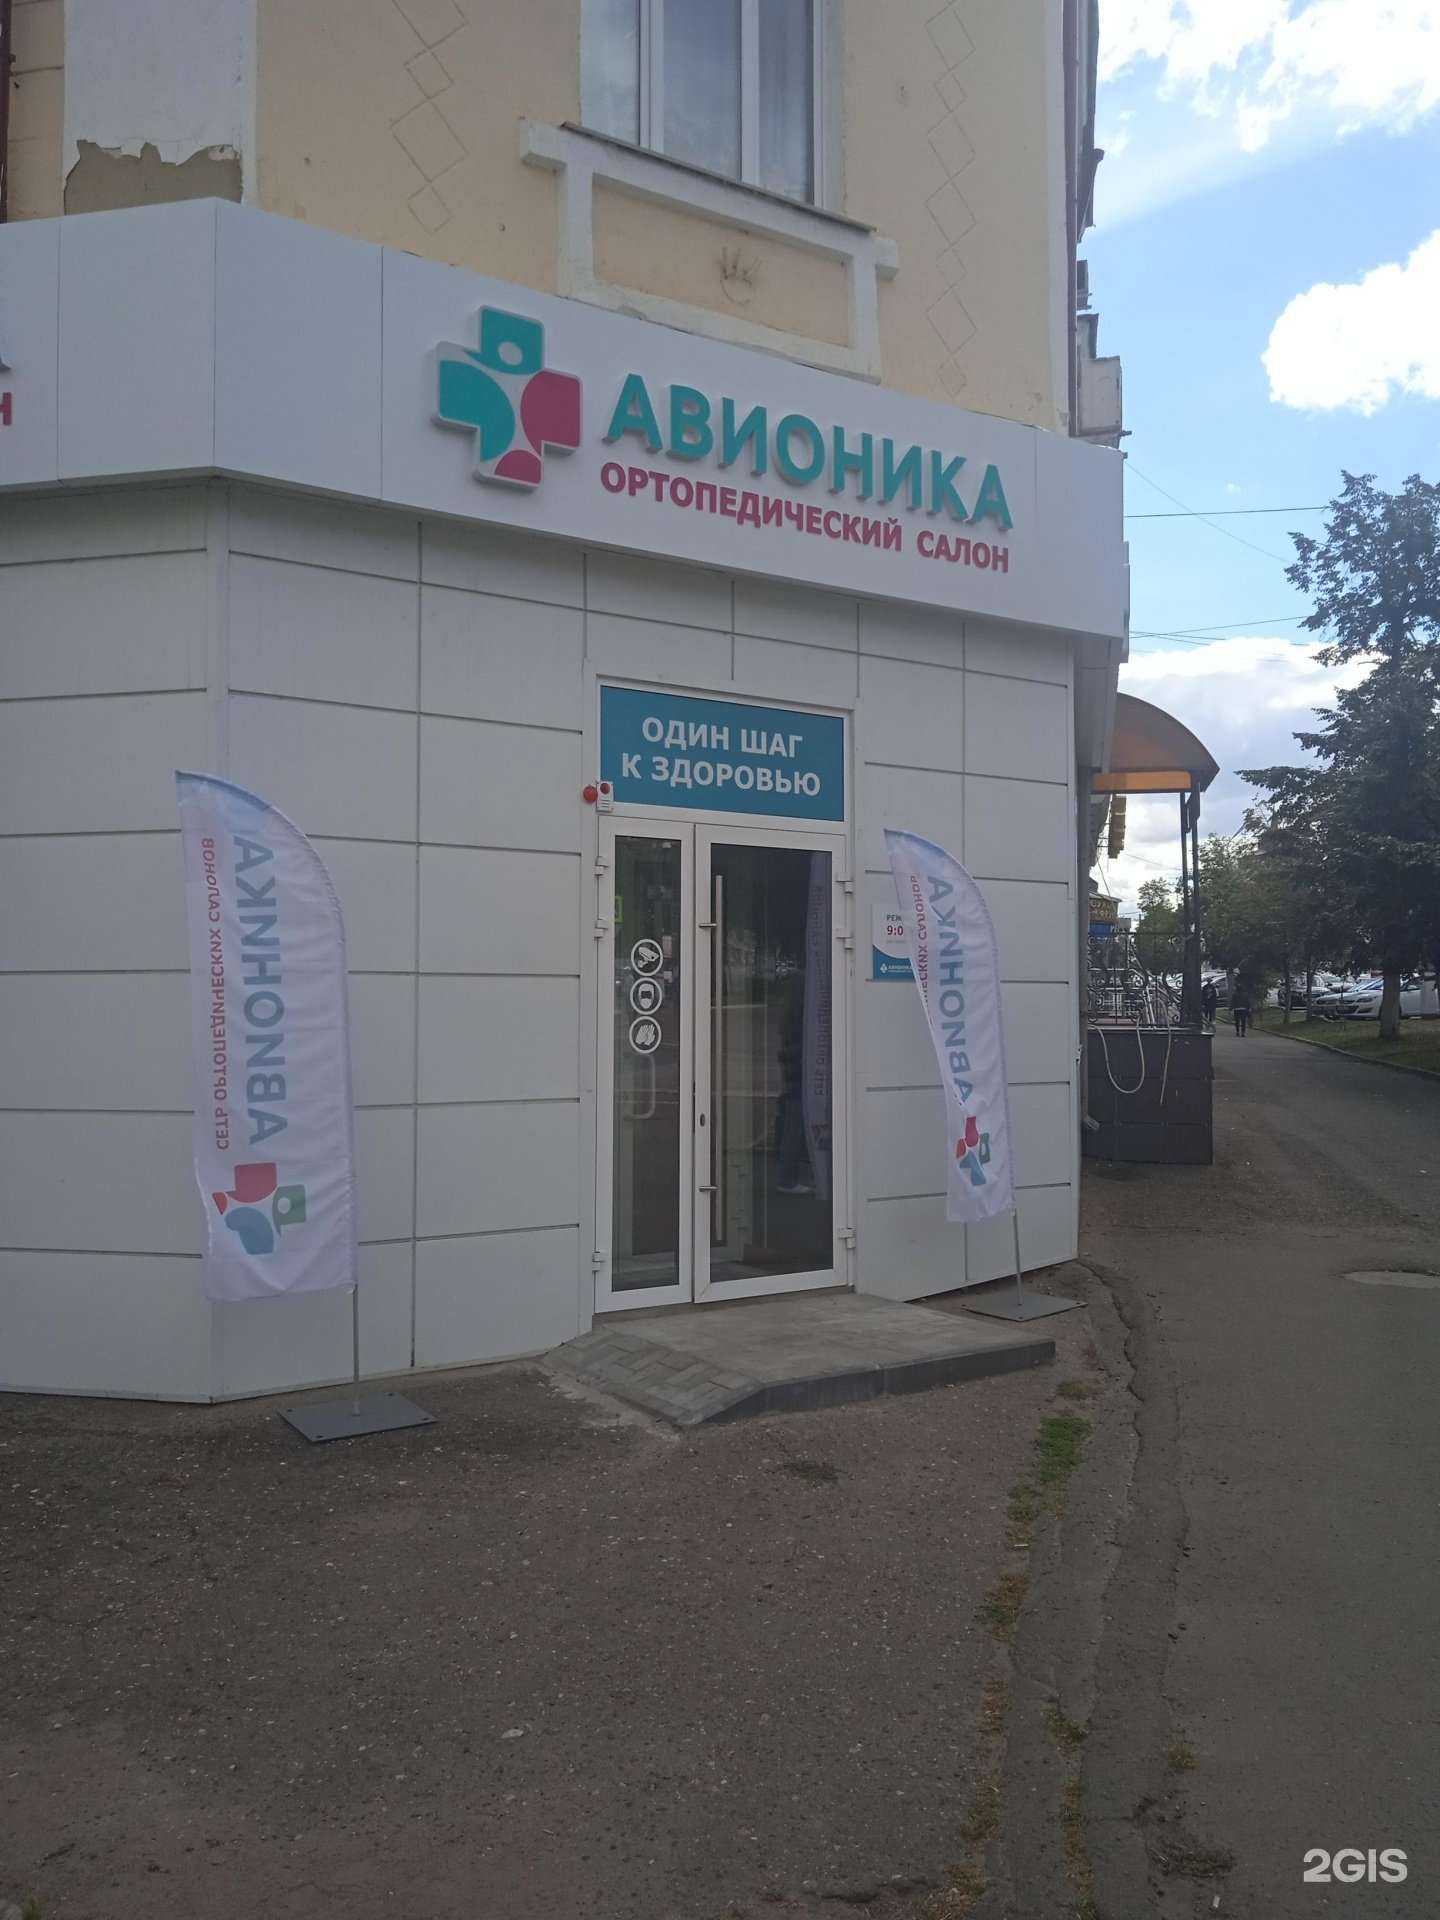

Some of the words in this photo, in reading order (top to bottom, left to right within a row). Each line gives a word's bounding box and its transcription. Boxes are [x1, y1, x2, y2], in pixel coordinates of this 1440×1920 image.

[602, 373, 1014, 531] АВИОНИКА
[600, 462, 902, 551] ОРТОПЕДИЧЕСКИЙ
[916, 530, 1010, 573] САЛОН
[622, 753, 642, 779] К
[652, 756, 821, 797] ЗДОРОВЬЮ
[642, 717, 730, 751] ОДИН
[740, 729, 803, 758] ШАГ
